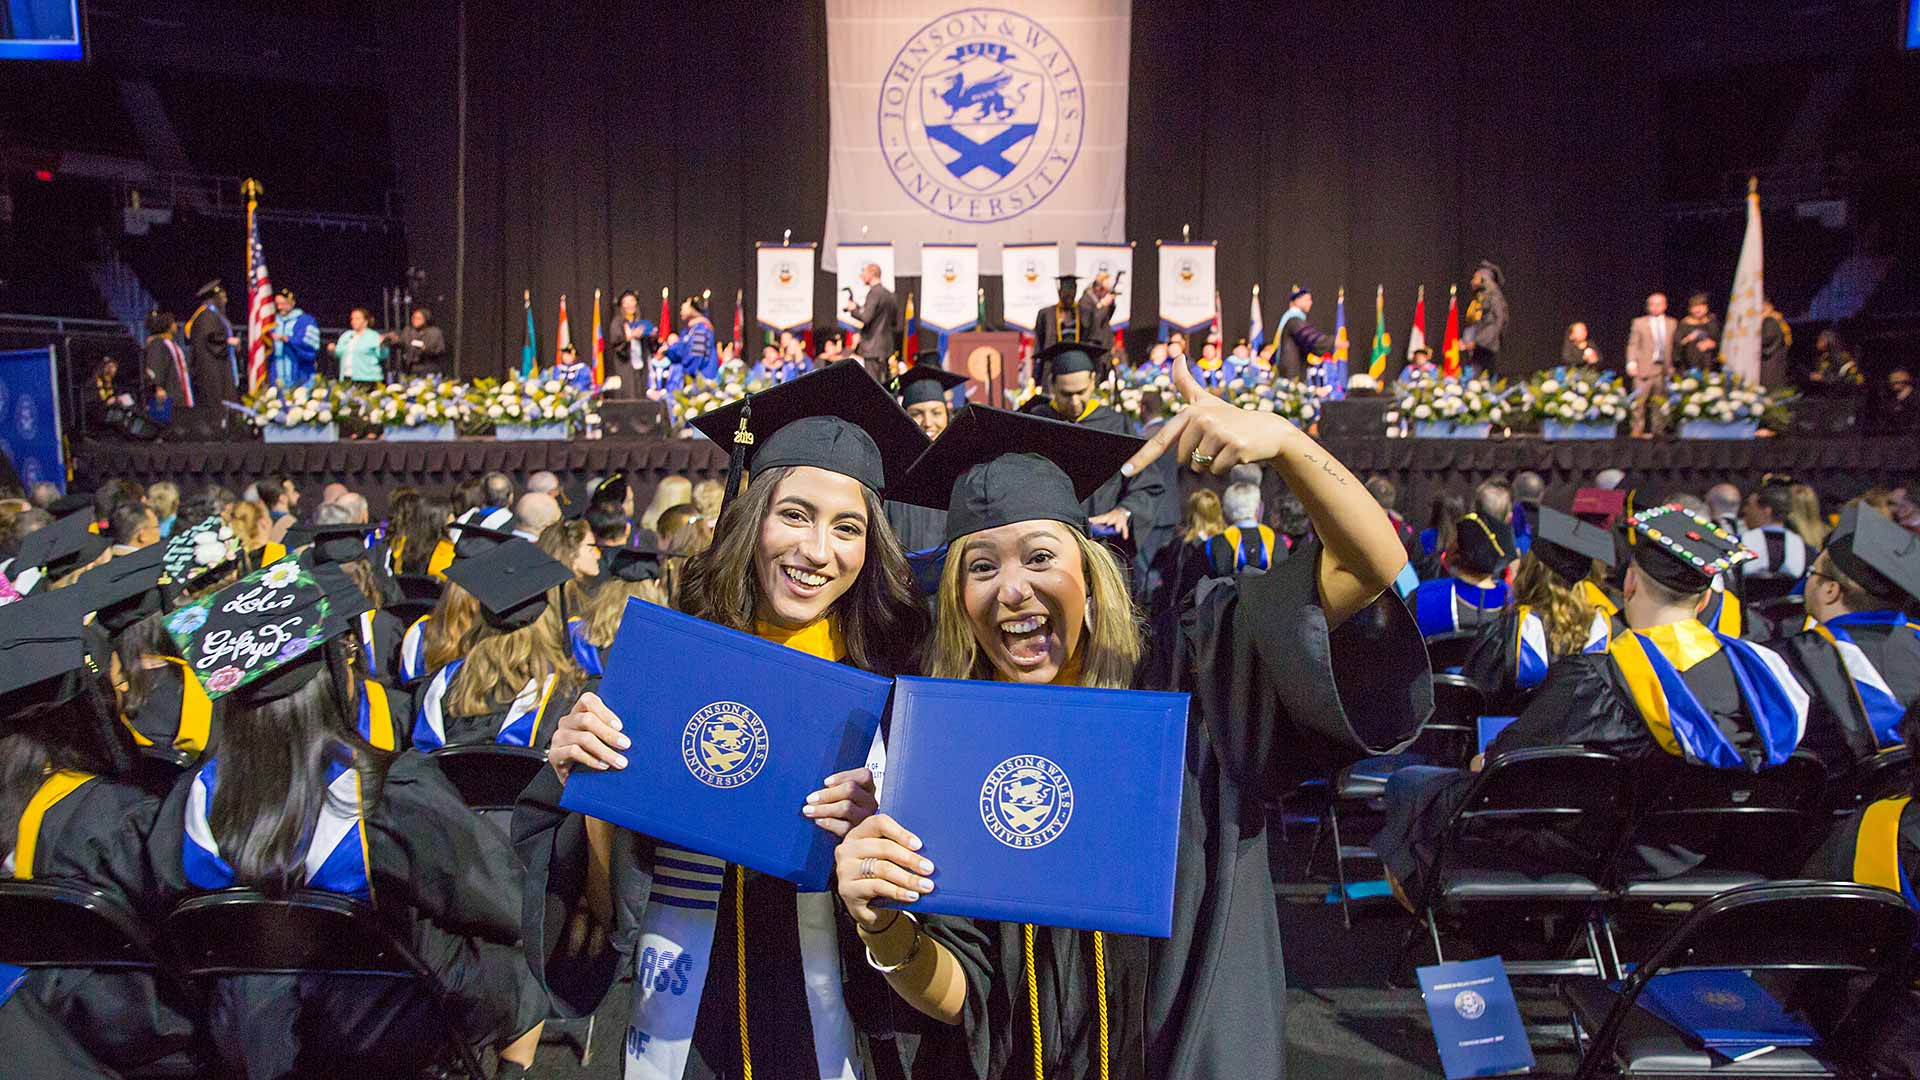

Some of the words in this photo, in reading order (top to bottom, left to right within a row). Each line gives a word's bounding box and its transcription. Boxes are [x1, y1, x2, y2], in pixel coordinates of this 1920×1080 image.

[884, 14, 988, 120] JOHNSON
[998, 18, 1015, 36] &
[1026, 26, 1079, 121] WALES
[893, 149, 1069, 218] UNIVERSITY
[734, 430, 754, 445] 2019
[686, 703, 740, 738] JOHNSON
[742, 709, 750, 720] &
[750, 717, 766, 760] WALES
[685, 747, 755, 786] UNIVERSITY
[983, 757, 1034, 802] JOHNSON
[1036, 759, 1046, 769] &
[1047, 764, 1070, 809] WALES
[985, 813, 1064, 846] UNIVERSITY
[639, 946, 693, 996] ASS
[628, 1024, 651, 1061] OF
